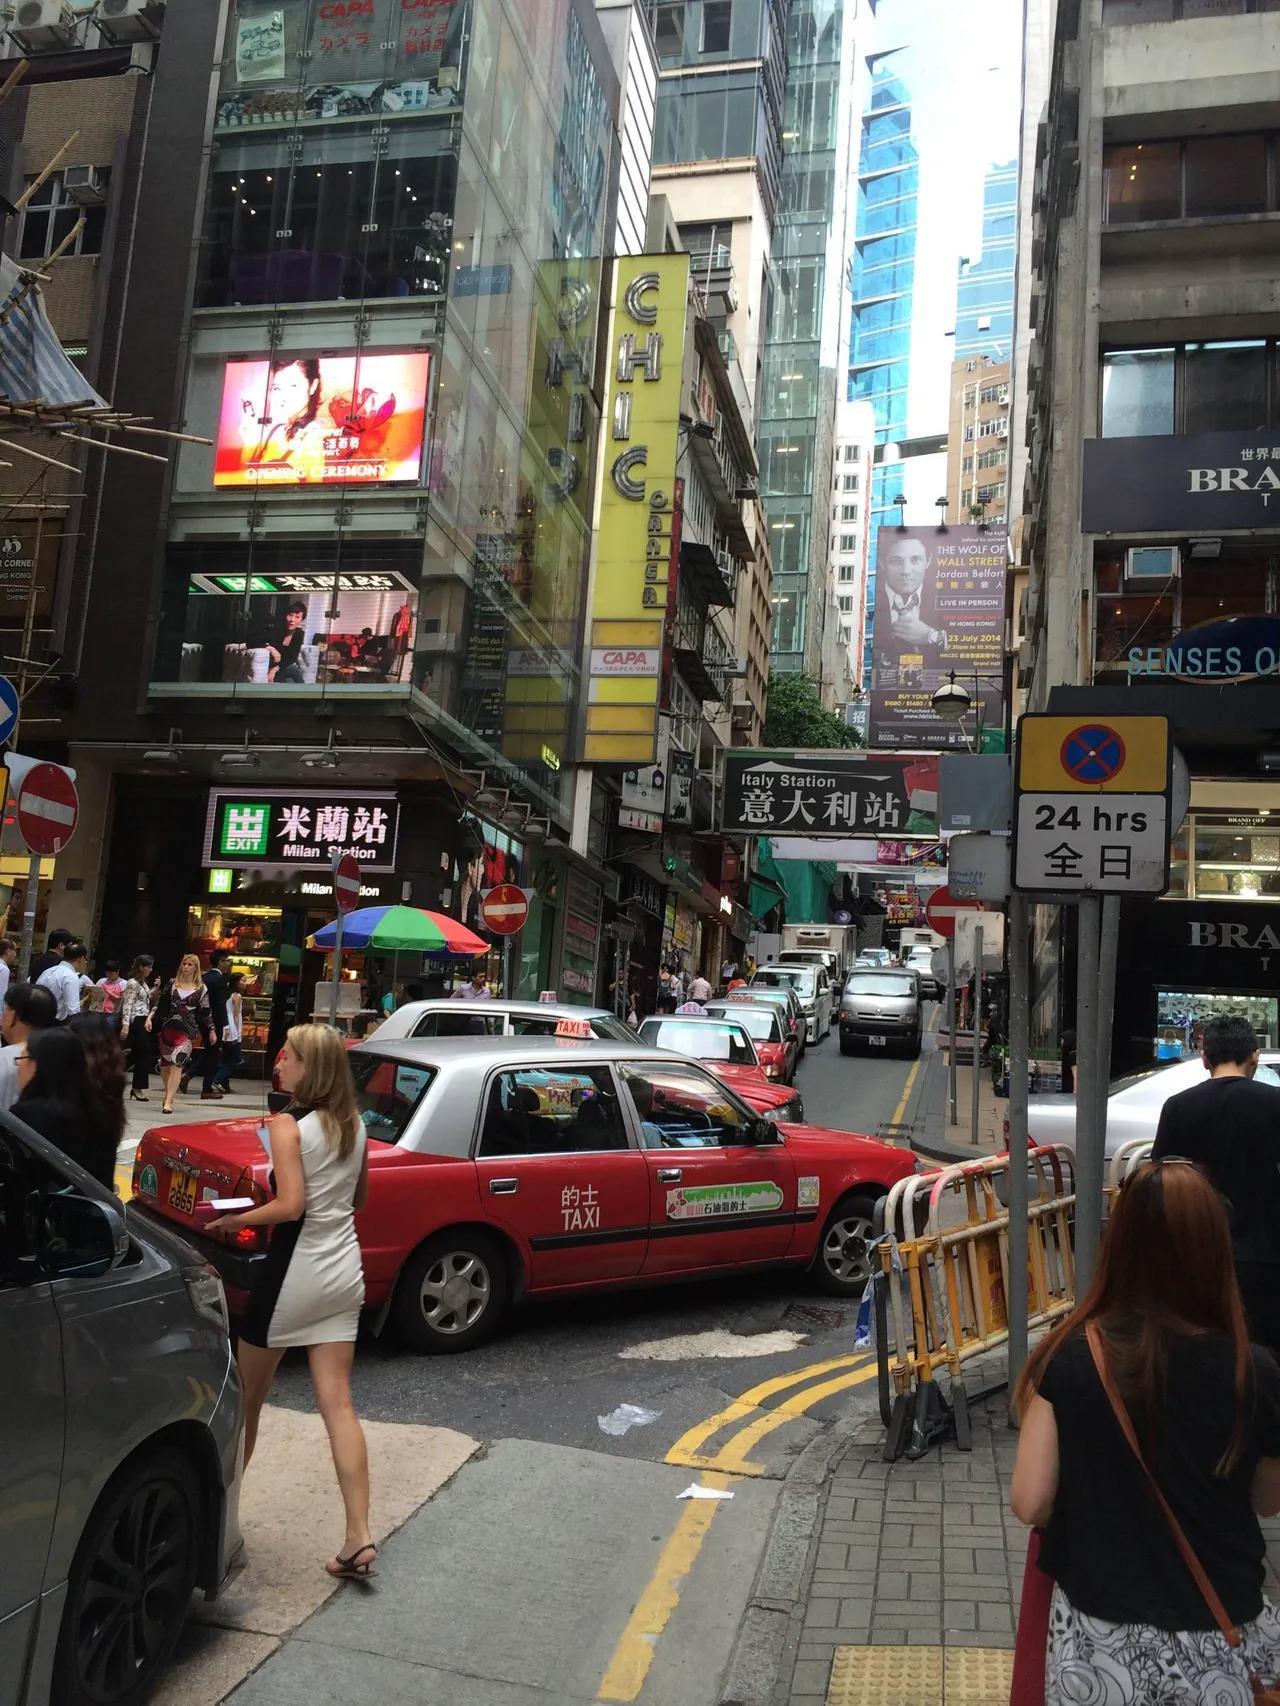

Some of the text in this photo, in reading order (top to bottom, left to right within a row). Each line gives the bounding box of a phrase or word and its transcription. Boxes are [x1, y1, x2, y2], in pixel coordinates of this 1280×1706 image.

[319, 1, 374, 20] CAPA
[611, 271, 661, 502] CHIC
[936, 544, 1006, 555] THE WOLF OF
[936, 556, 1004, 567] WALL STREET
[936, 568, 1004, 579] Jordan Belfort
[960, 635, 978, 643] July
[980, 634, 1001, 642] 2014
[602, 651, 647, 665] CAPA
[1127, 646, 1280, 676] SENSES O
[741, 772, 836, 789] Italy Station
[738, 788, 902, 828] 意大利站
[276, 804, 389, 844] 米蘭站
[1035, 804, 1148, 832] 24 hrs
[226, 838, 261, 850] EXIT
[283, 844, 377, 859] Milan Station
[1043, 841, 1132, 880] 全日
[301, 882, 333, 894] Milan
[558, 1019, 581, 1035] TAXI
[169, 1187, 194, 1213] 2865
[561, 1184, 599, 1207] 的士
[562, 1206, 600, 1231] TAXI
